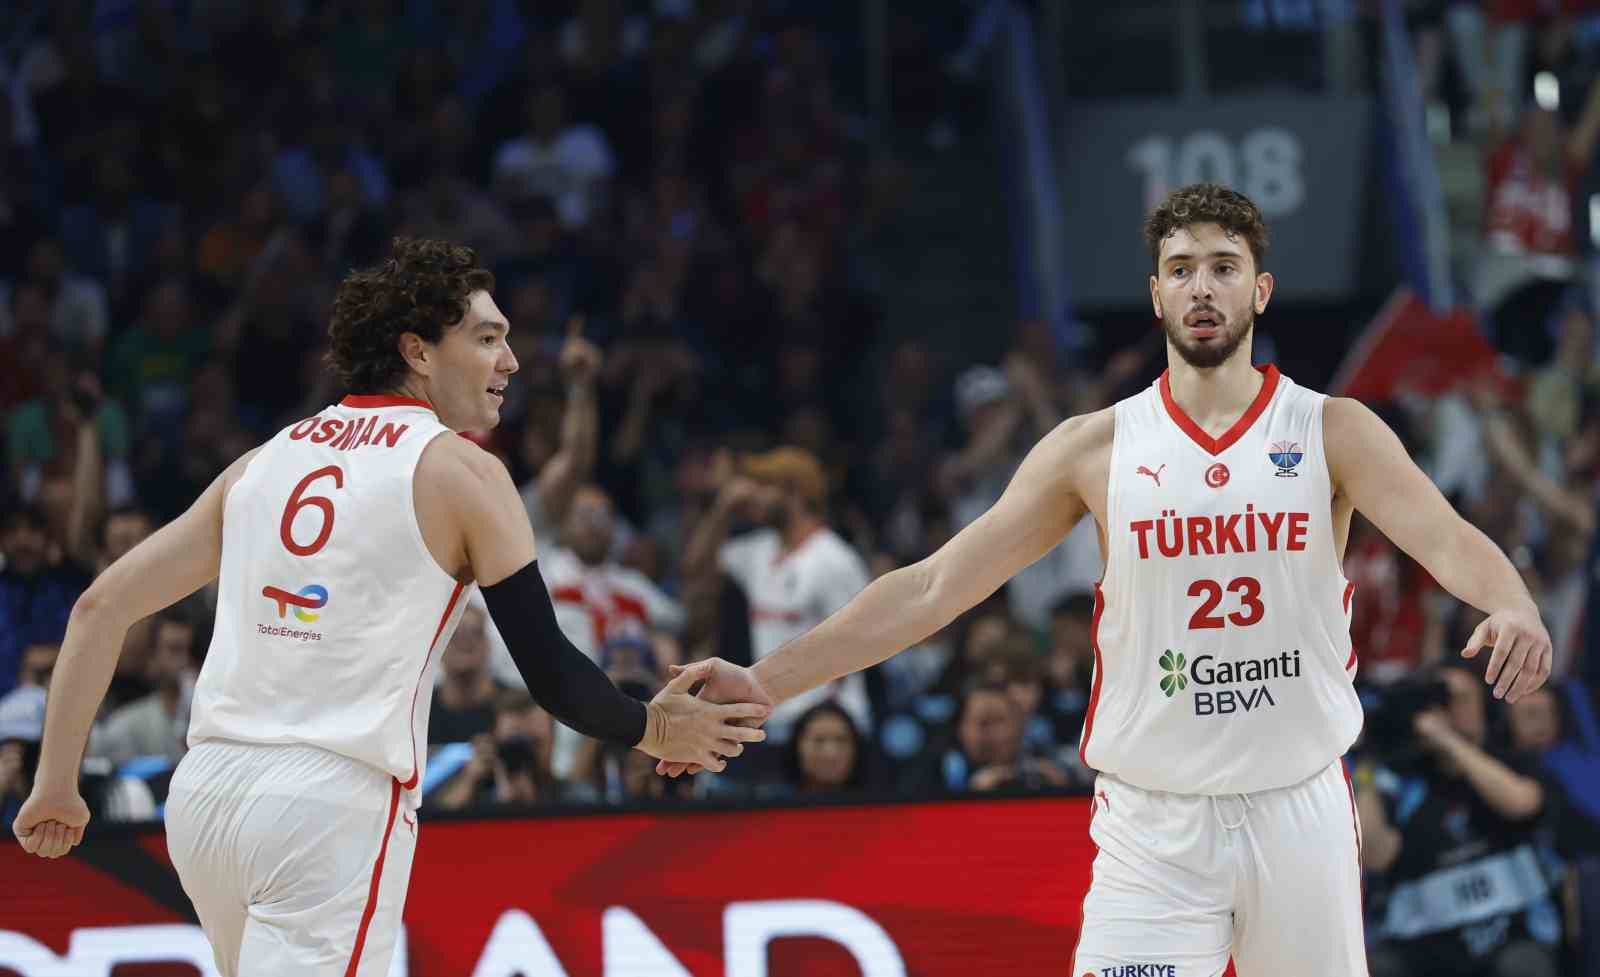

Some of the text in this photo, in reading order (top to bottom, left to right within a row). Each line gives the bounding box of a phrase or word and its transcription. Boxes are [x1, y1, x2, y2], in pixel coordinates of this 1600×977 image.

[1129, 128, 1304, 215] 108
[289, 416, 409, 450] OSMAN
[280, 465, 344, 557] 6
[1130, 503, 1309, 560] TÜRKİYE
[1187, 576, 1265, 630] 23
[257, 624, 322, 641] TotalEnergies
[1190, 650, 1300, 685] Garanti
[1194, 685, 1275, 716] BBVA
